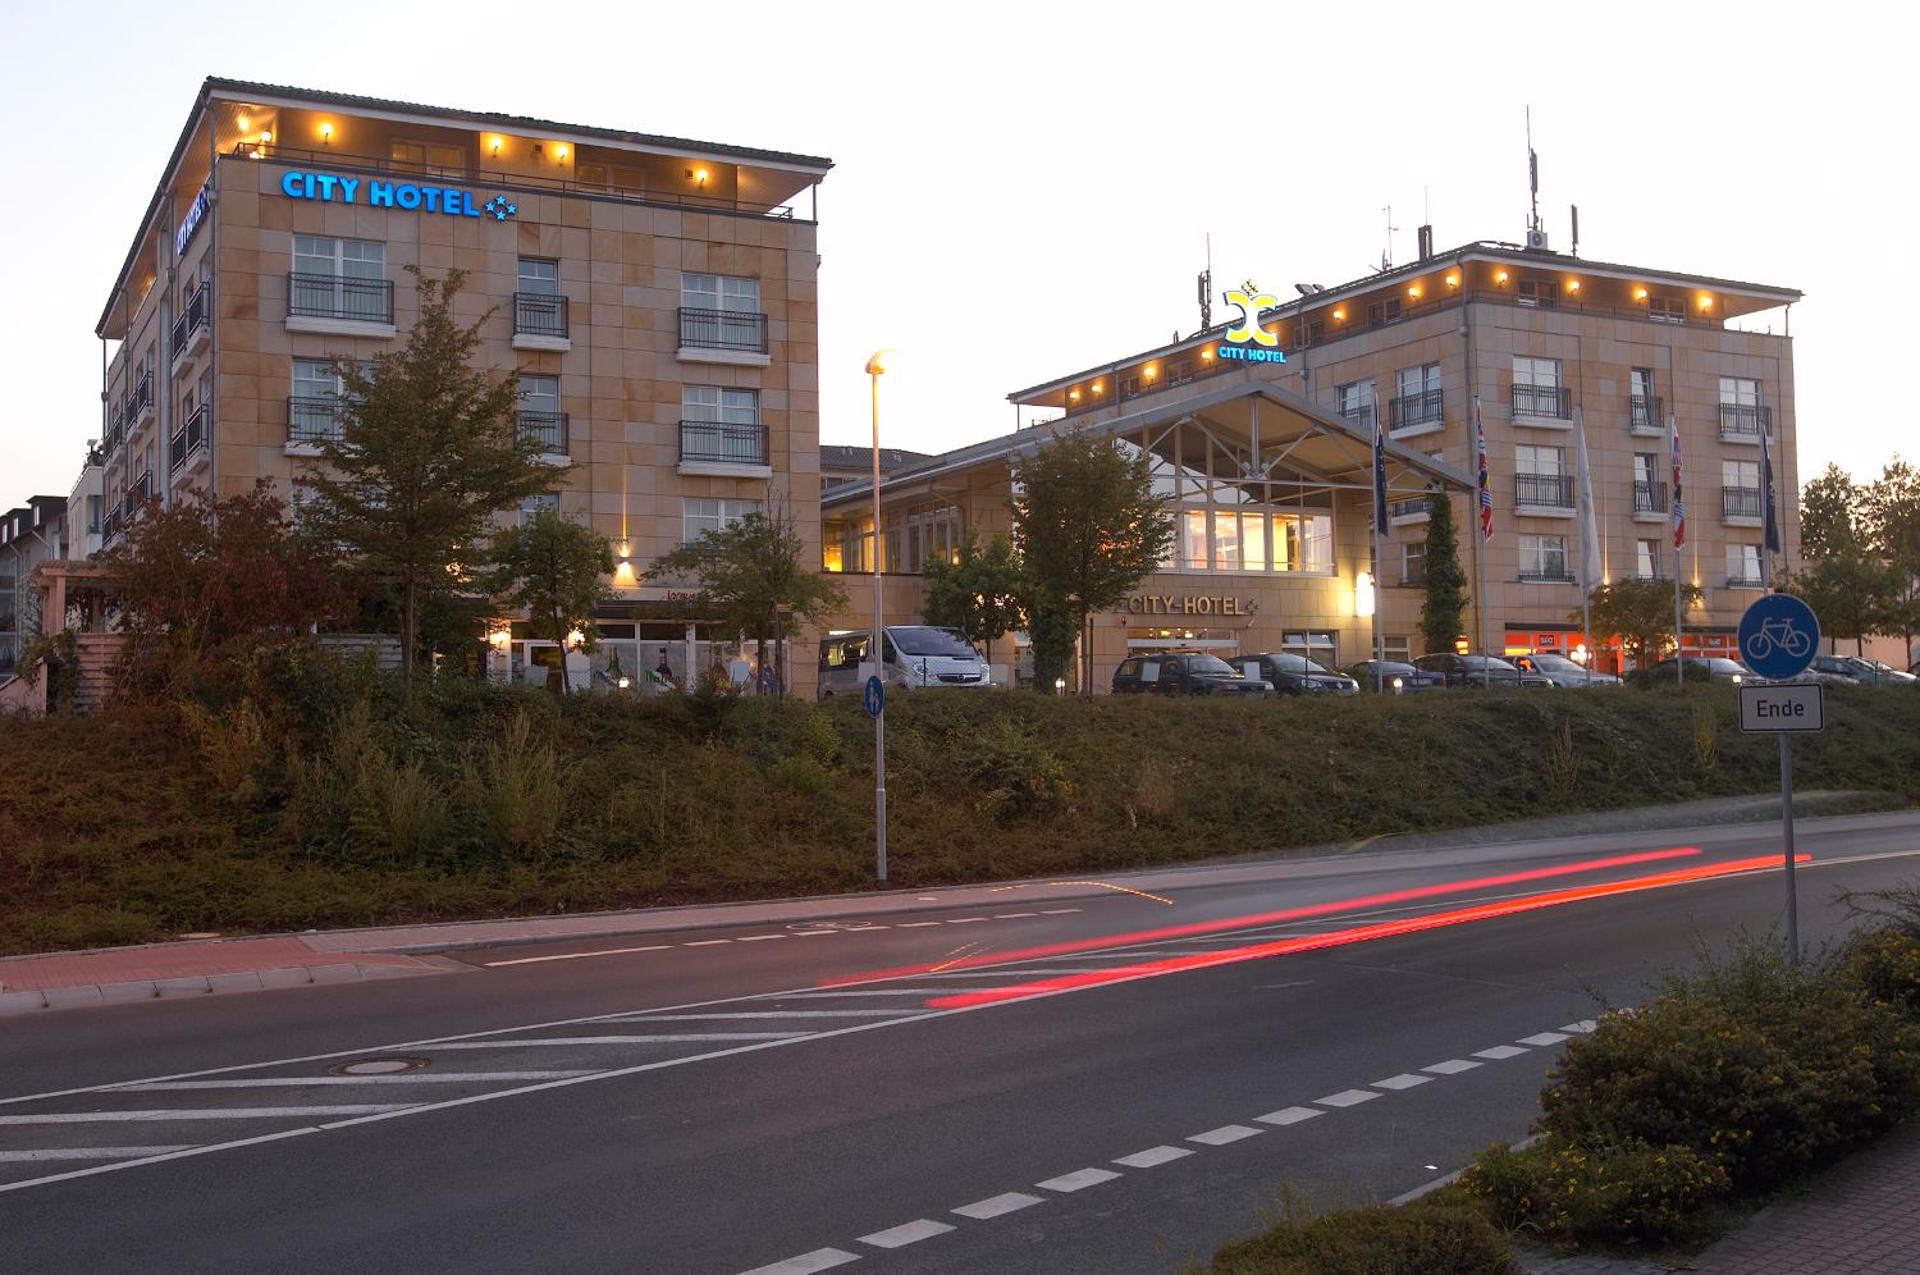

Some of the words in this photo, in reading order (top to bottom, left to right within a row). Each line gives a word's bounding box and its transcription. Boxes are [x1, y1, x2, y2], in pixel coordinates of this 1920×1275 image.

[281, 171, 359, 203] CITY
[369, 180, 481, 218] HOTEL
[1218, 346, 1245, 360] CITY
[1247, 348, 1286, 364] HOTEL
[1756, 699, 1804, 717] Ende
